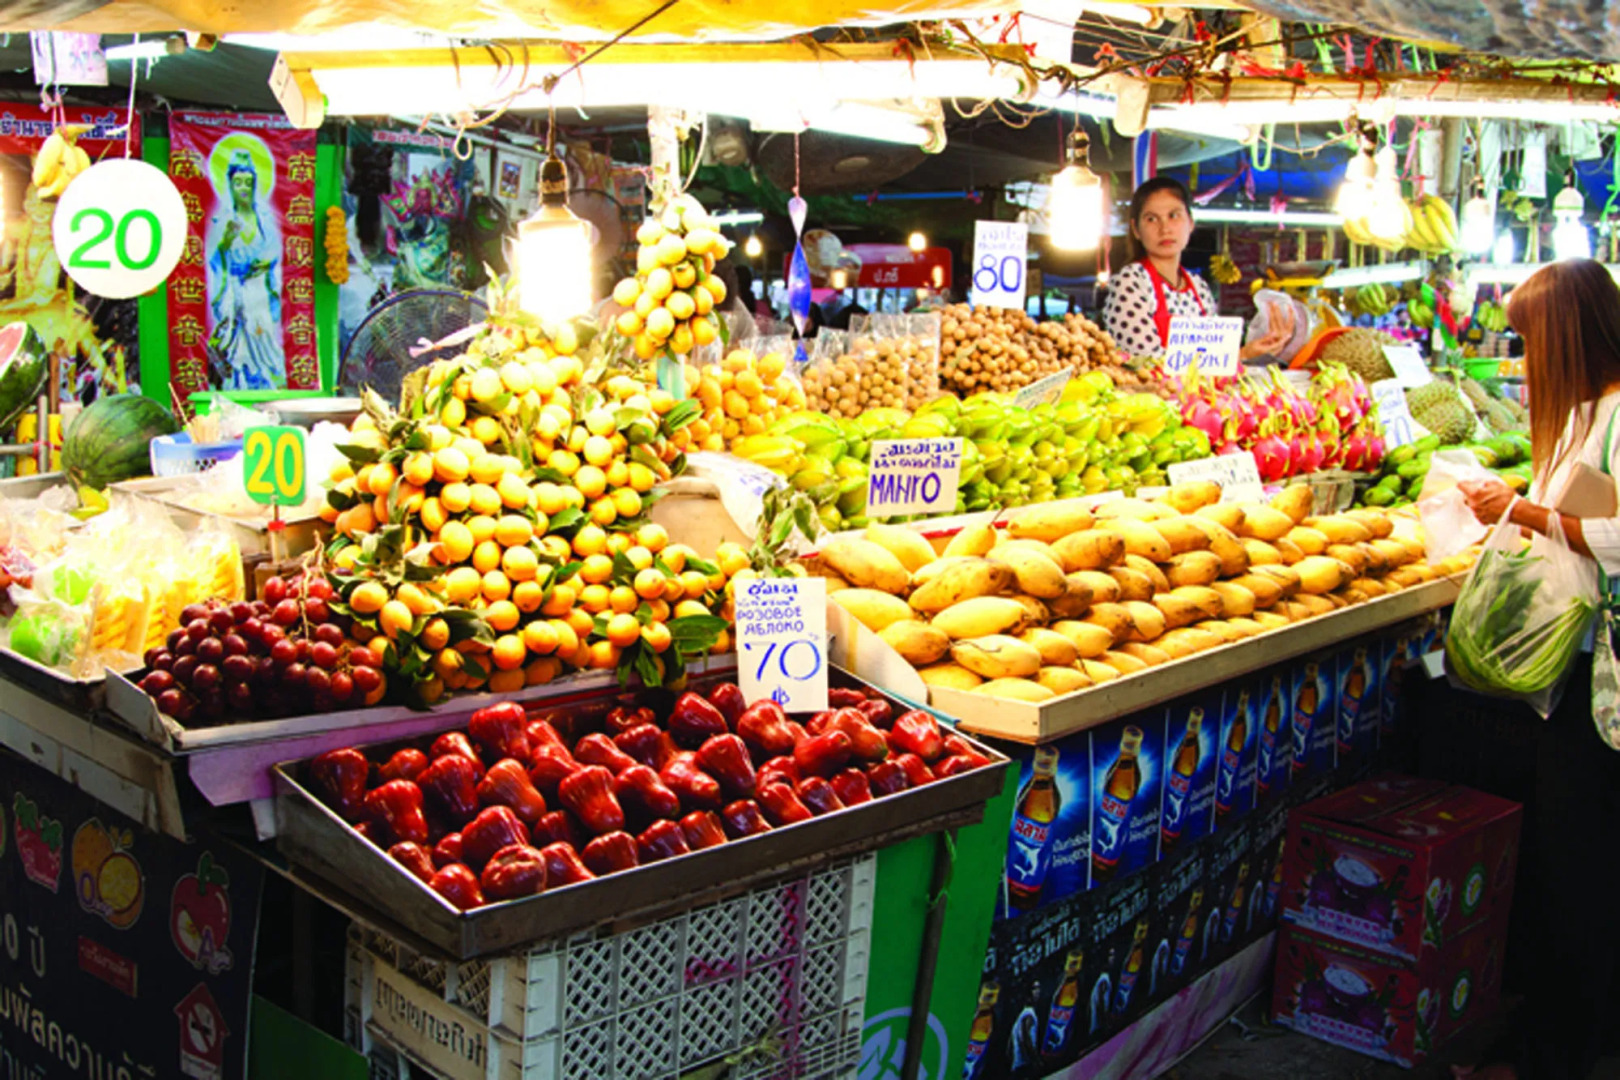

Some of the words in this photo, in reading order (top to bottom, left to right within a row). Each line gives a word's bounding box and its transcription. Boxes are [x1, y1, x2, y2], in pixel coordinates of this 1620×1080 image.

[68, 207, 162, 270] 20
[973, 254, 1022, 292] 80
[246, 431, 304, 497] 20
[744, 639, 821, 682] 70
[0, 912, 19, 961] 0
[26, 925, 46, 978] ปี
